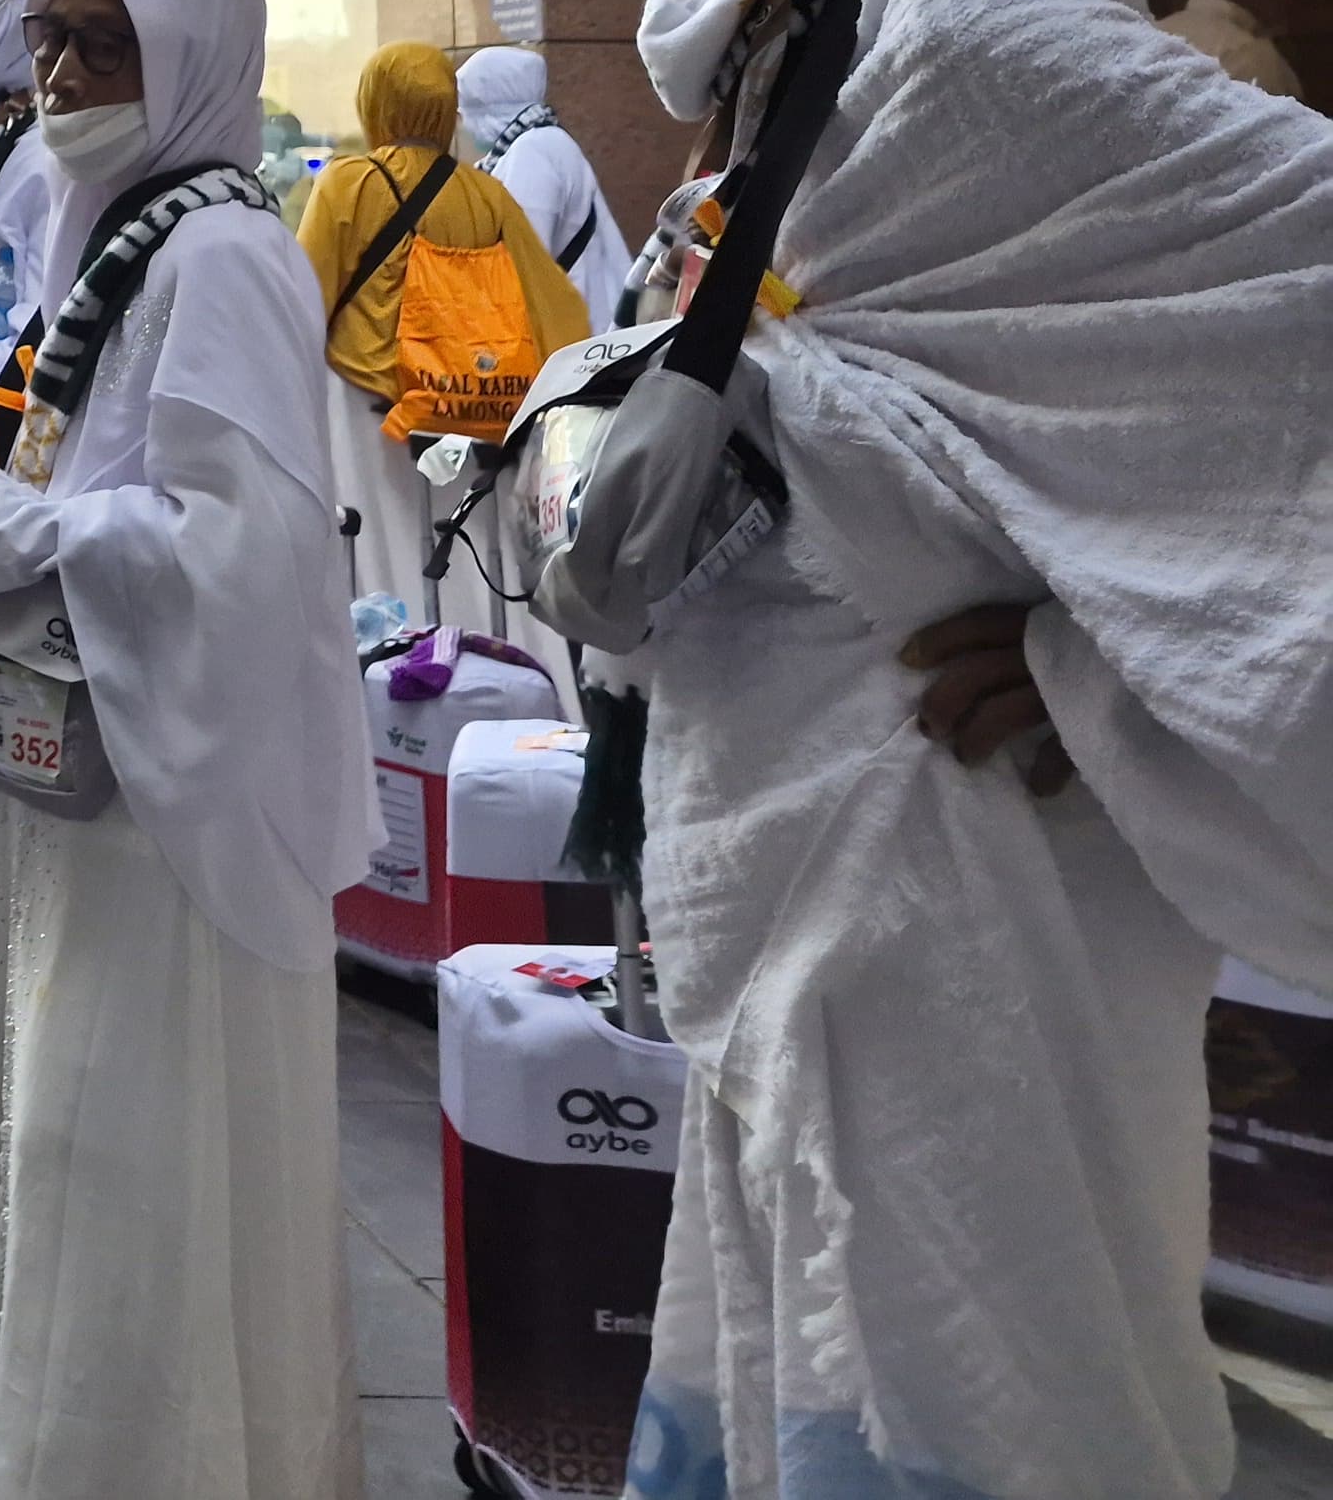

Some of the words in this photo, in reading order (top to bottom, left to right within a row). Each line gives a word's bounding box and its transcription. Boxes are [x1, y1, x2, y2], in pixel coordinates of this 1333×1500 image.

[540, 495, 563, 535] 351
[10, 732, 60, 770] 352
[566, 1131, 652, 1155] aybe
